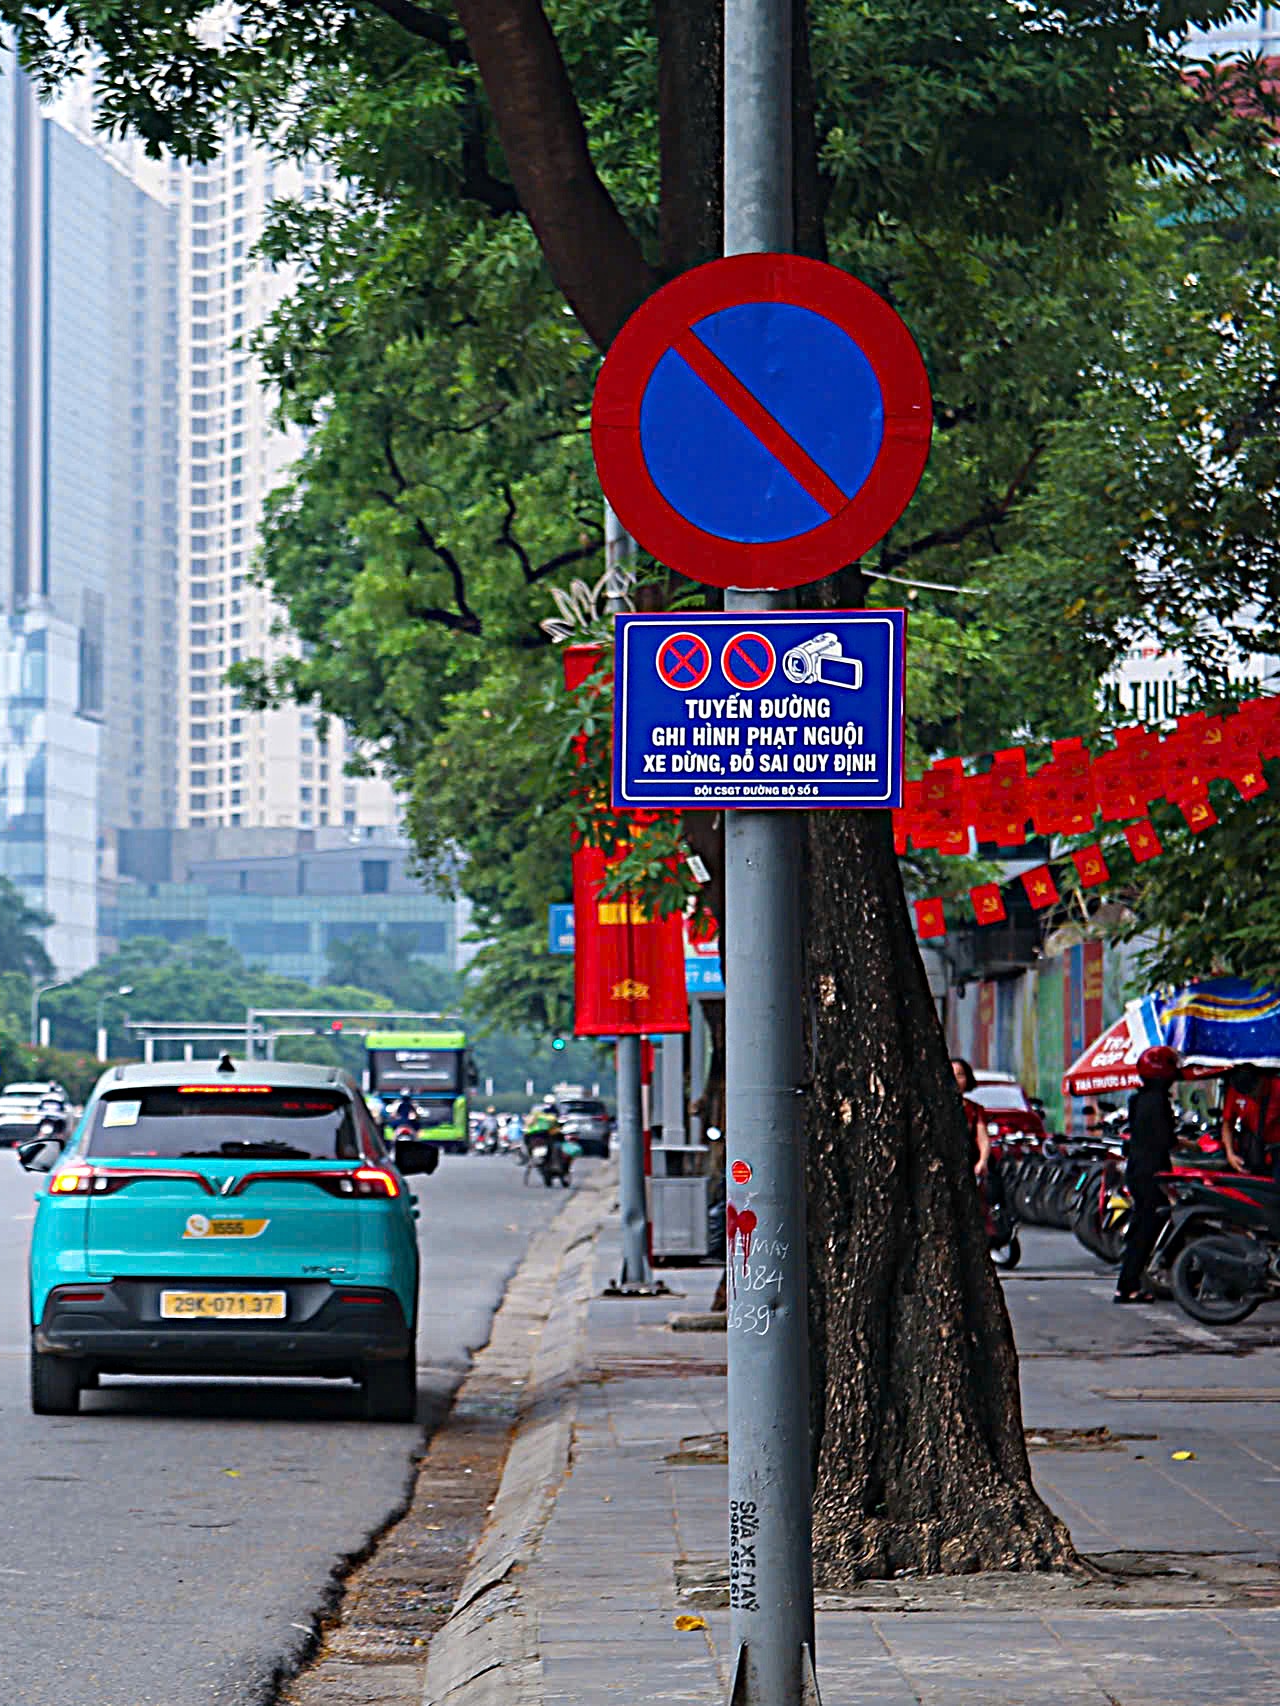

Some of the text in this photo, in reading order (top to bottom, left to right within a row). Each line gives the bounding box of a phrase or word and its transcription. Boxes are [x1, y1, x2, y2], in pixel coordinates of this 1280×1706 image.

[685, 692, 831, 719] TUYẾN ĐƯỜNG
[652, 721, 864, 750] GHI HÌNH PHẠT NGUỘI
[643, 748, 877, 777] XE DỪNG, ĐỖ SAI QUY ĐỊNH
[714, 786, 741, 796] CSGT
[781, 784, 796, 798] BỘ
[812, 786, 819, 796] 6
[740, 1544, 756, 1568] XE
